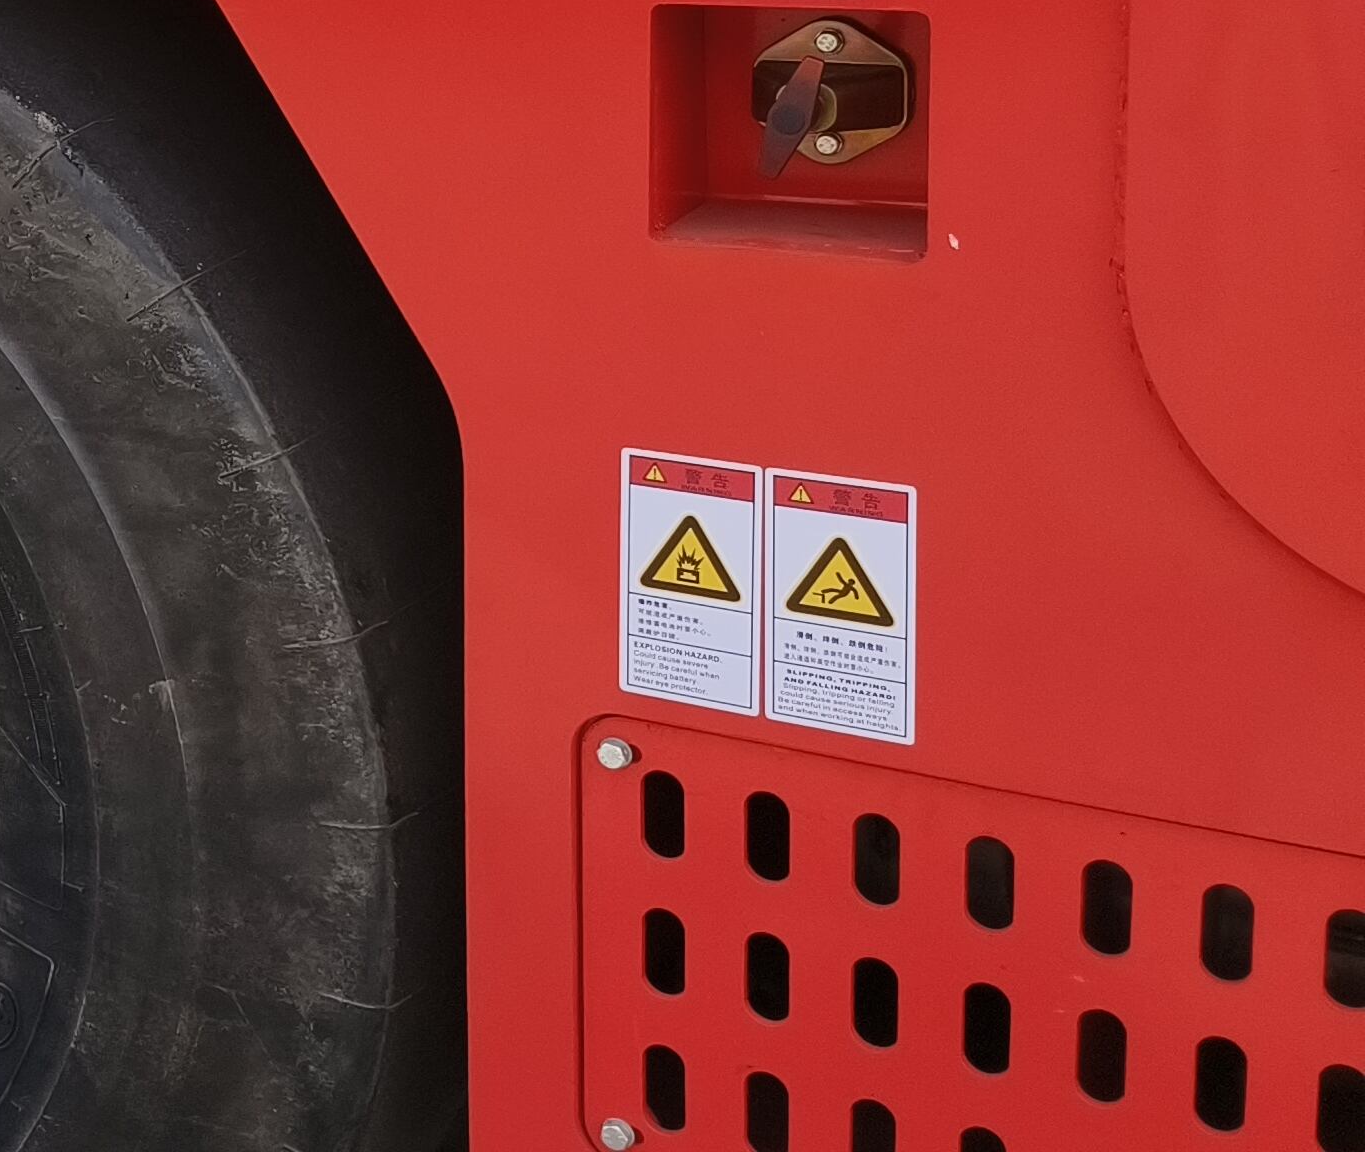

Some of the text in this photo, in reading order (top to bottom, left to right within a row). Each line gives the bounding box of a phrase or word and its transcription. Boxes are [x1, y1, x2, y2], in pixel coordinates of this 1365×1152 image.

[684, 468, 730, 489] 警告
[832, 489, 881, 511] 警告
[634, 640, 682, 655] EXPLOSION
[634, 649, 708, 669] Could cause severe
[634, 667, 667, 679] servicing
[634, 675, 653, 684] Wear
[655, 680, 668, 688] eye
[671, 665, 697, 675] careful
[699, 671, 719, 679] when
[786, 667, 835, 682] SLIPPING,
[783, 675, 895, 700] AND FALLING HAZARD!
[777, 695, 789, 703] Be
[791, 697, 820, 709] careful
[832, 706, 862, 716] access
[865, 712, 886, 722] ways
[780, 688, 803, 699] could
[805, 694, 830, 703] cause
[833, 698, 864, 710] serious
[822, 689, 854, 701] tripping
[868, 697, 894, 708] falling
[778, 703, 793, 711] and
[795, 706, 817, 716] when
[820, 711, 853, 723] working
